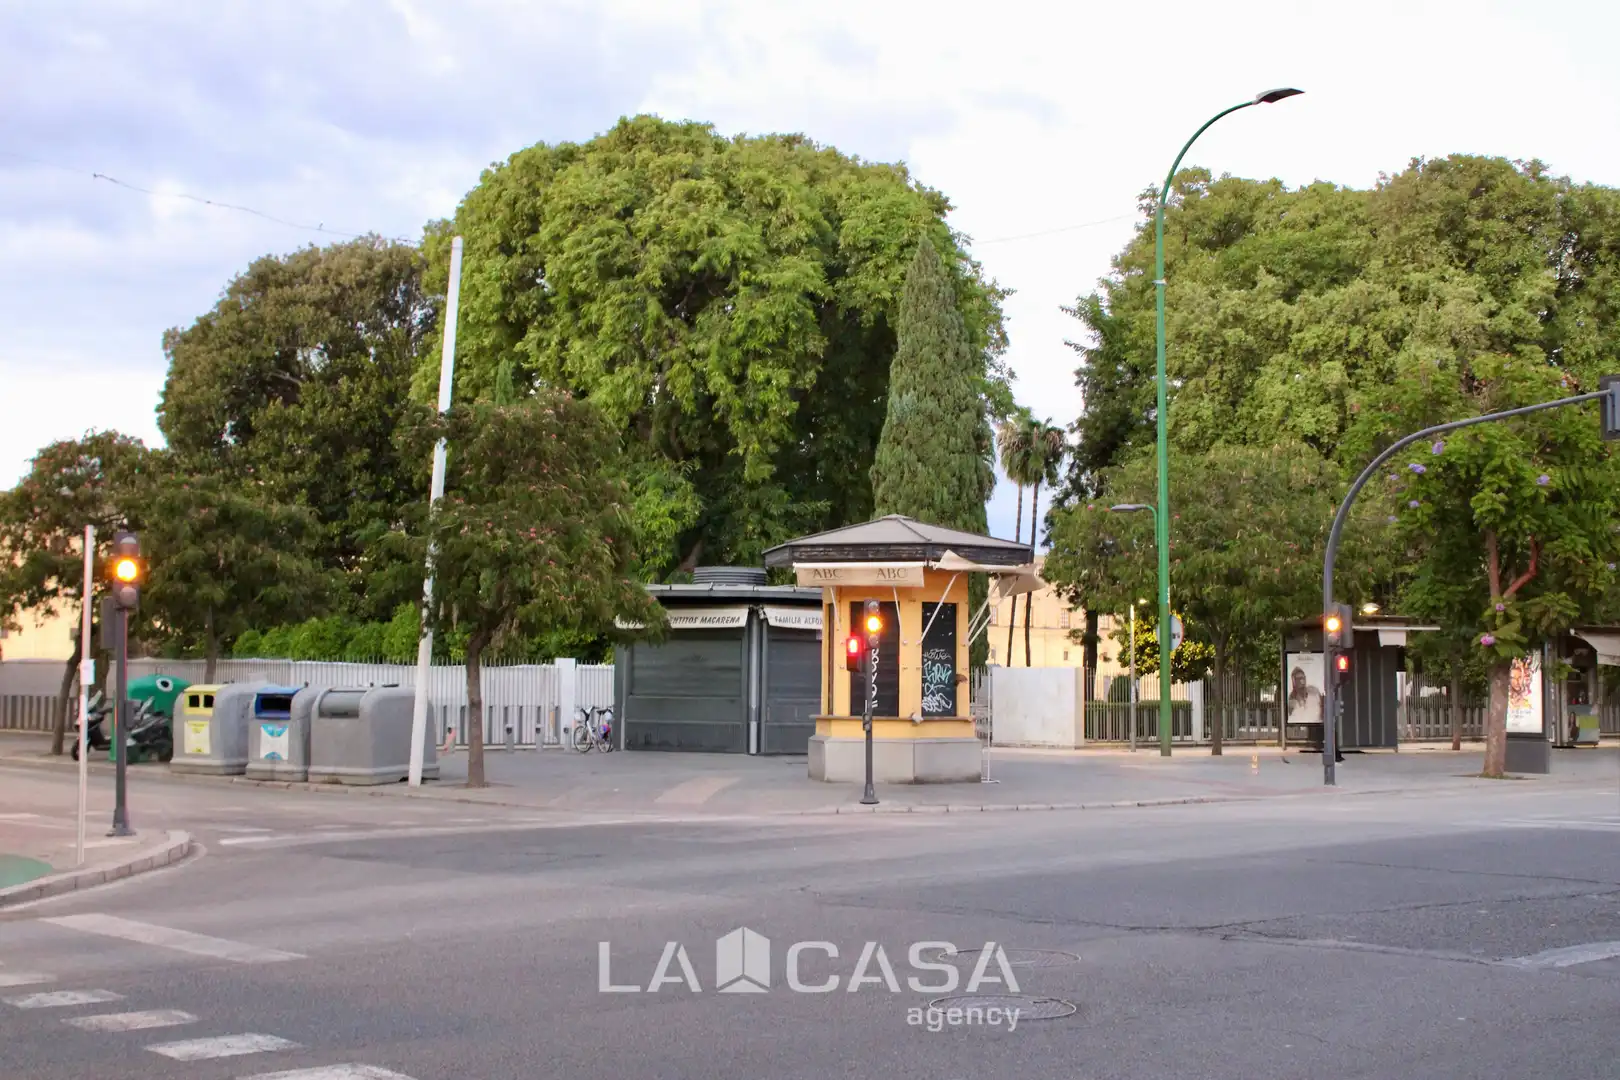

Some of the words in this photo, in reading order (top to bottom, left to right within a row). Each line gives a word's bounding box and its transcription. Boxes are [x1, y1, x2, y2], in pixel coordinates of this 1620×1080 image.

[812, 568, 844, 579] ABC
[876, 568, 908, 579] ABC
[700, 616, 741, 625] MACARENA
[774, 616, 802, 625] FAMILIA
